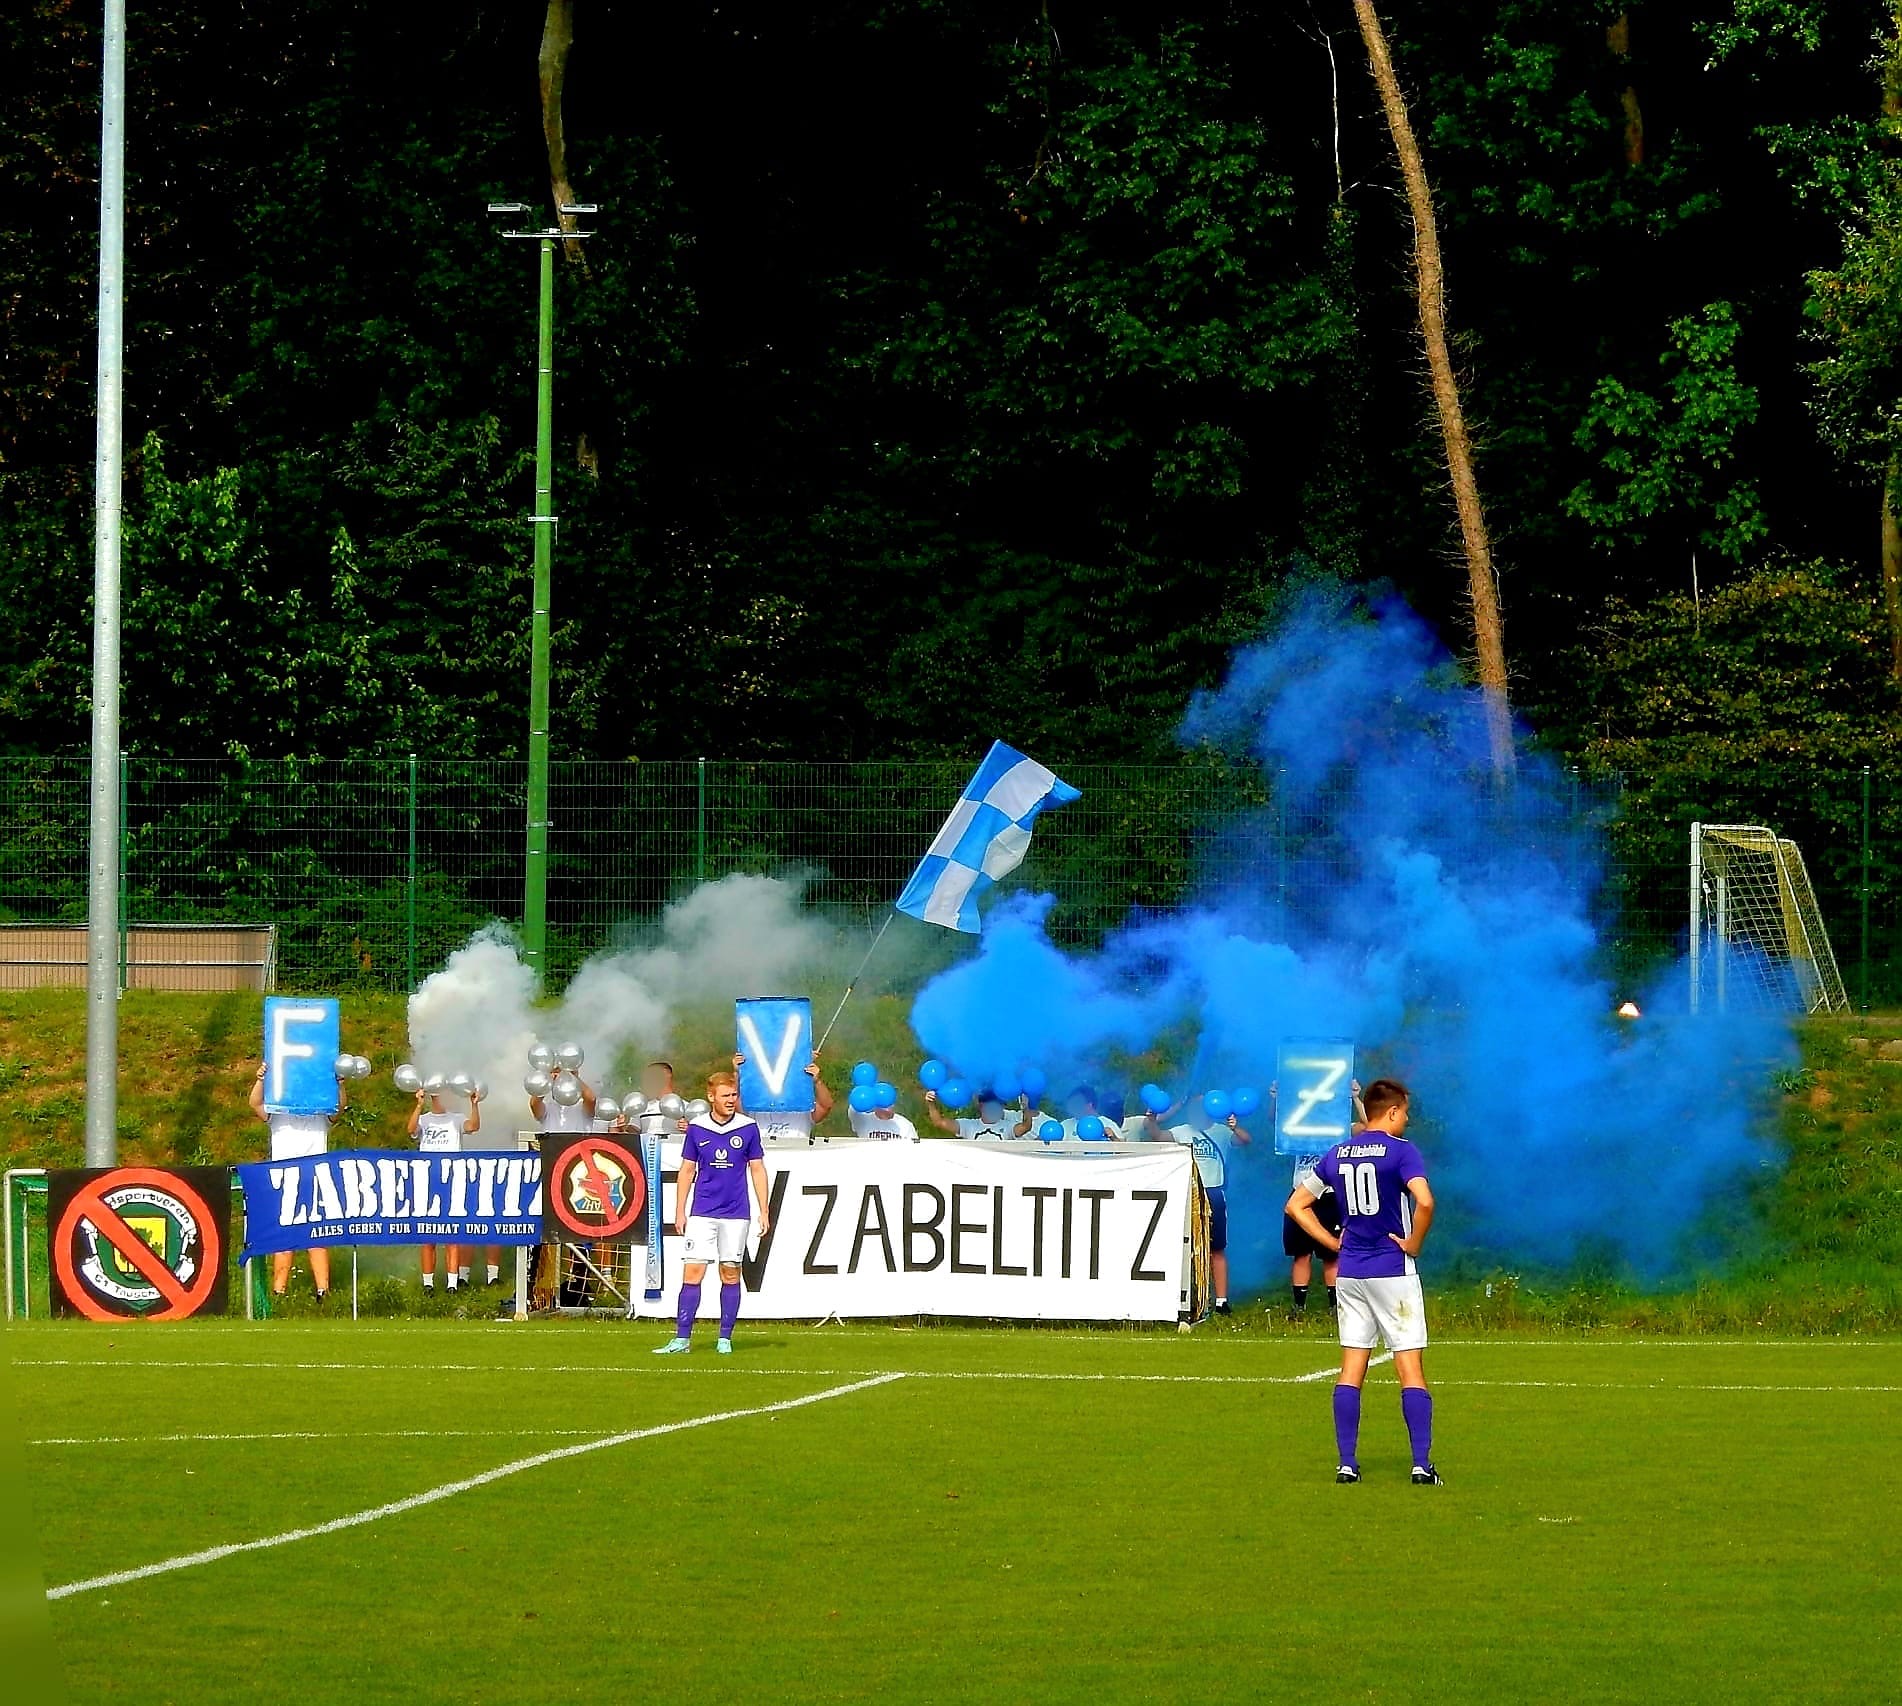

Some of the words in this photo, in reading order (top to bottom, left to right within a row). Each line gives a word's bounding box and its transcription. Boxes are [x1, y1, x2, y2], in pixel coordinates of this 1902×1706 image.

[273, 1008, 326, 1102] F
[739, 1015, 801, 1095] V
[1282, 1058, 1346, 1136] Z
[1339, 1163, 1380, 1216] 10
[310, 1224, 344, 1239] ALLES
[348, 1222, 383, 1235] GEBEN
[416, 1222, 460, 1234] HEIMAT
[465, 1223, 489, 1235] UND
[494, 1223, 535, 1234] VEREIN
[802, 1183, 1168, 1282] ZABELTITZ
